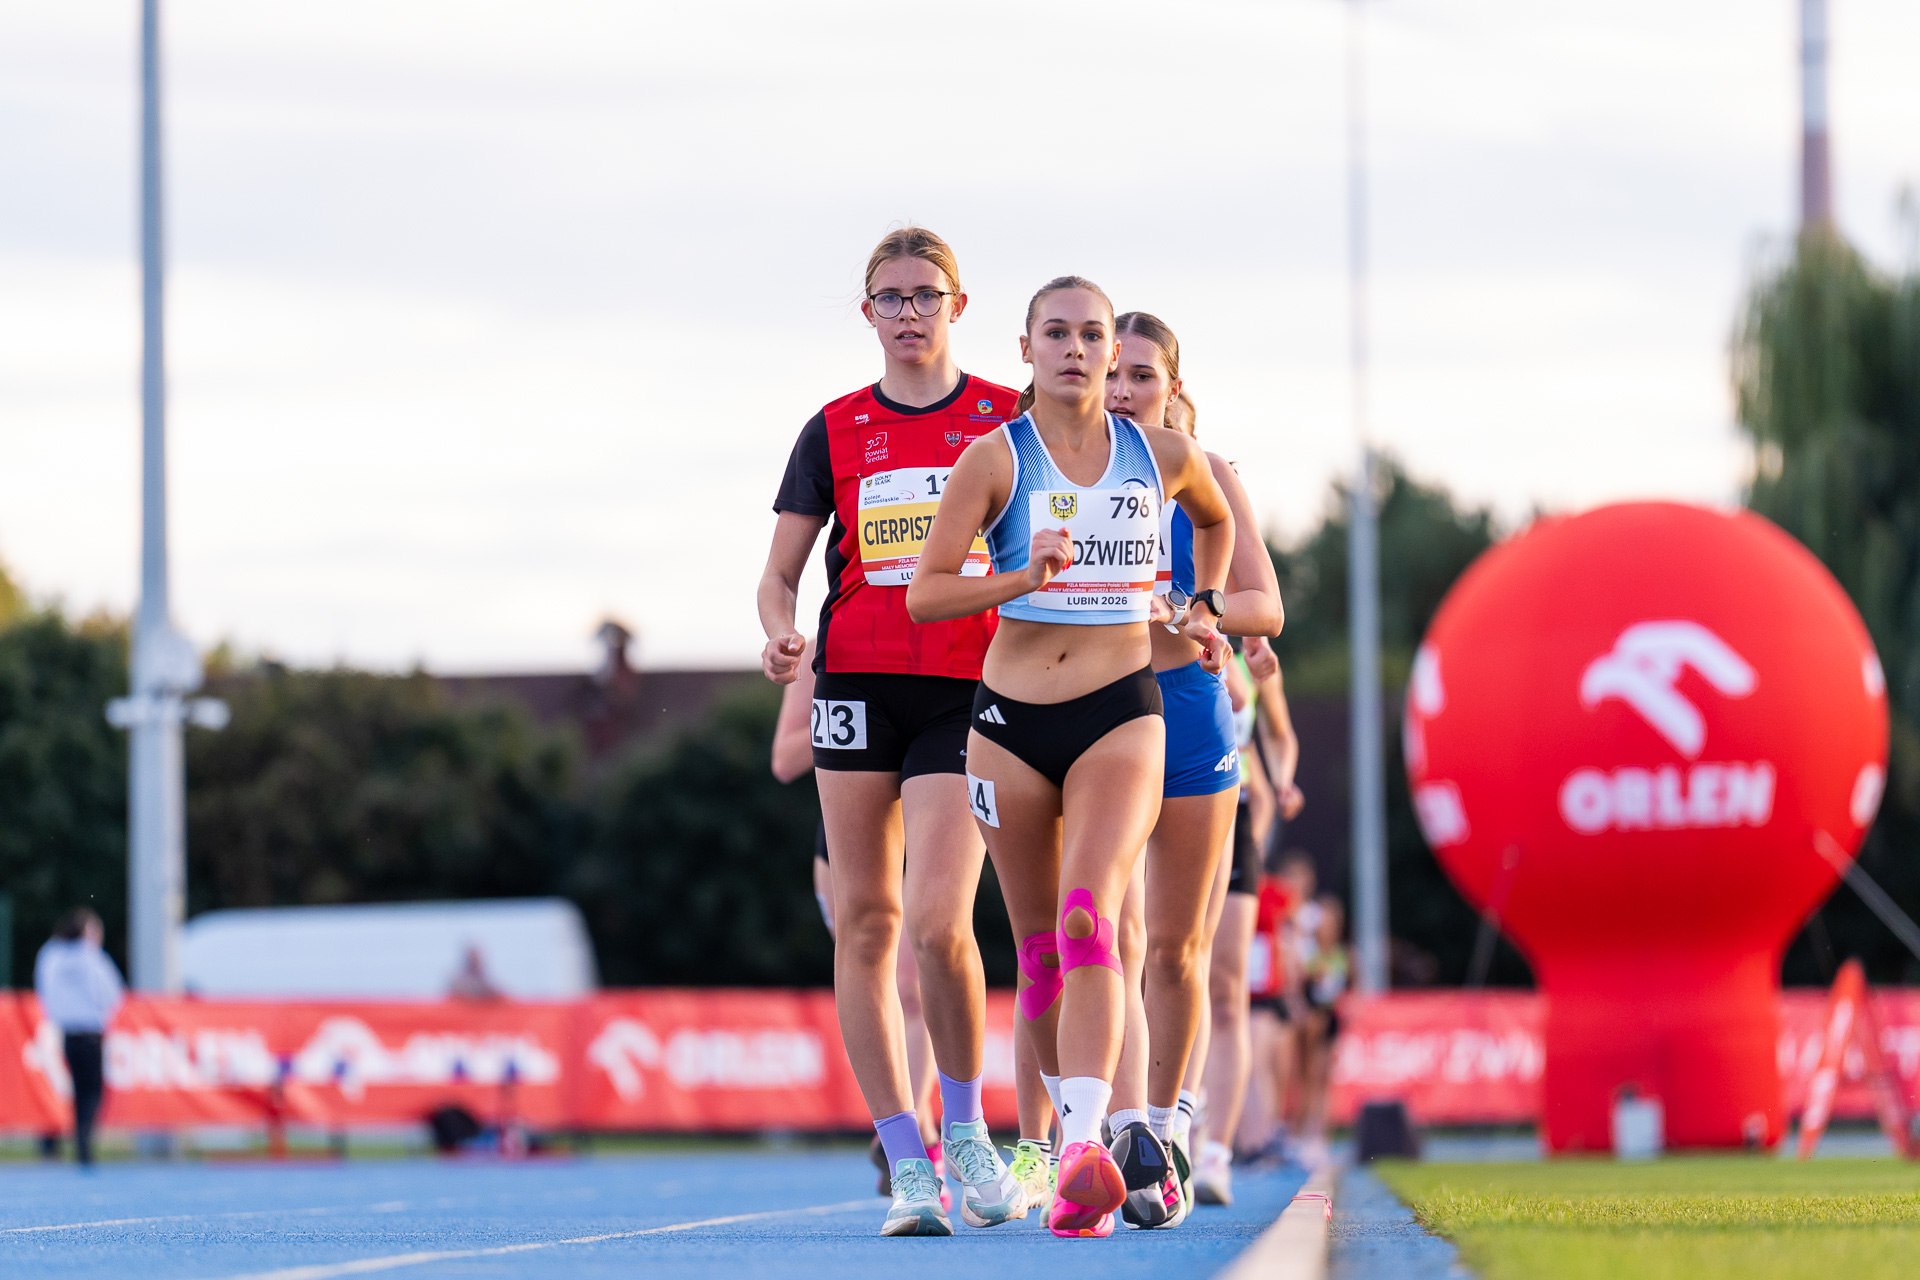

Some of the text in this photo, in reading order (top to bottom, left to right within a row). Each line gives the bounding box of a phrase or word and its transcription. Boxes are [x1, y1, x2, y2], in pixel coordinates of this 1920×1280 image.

[865, 447, 888, 458] Powiat
[1110, 496, 1149, 519] 796
[863, 515, 937, 546] CIERPISZ
[1071, 533, 1155, 566] DŹWIEDŹ
[1067, 596, 1128, 605] LUBIN 2026
[1214, 749, 1236, 772] 4F
[1558, 762, 1776, 834] ORLEN
